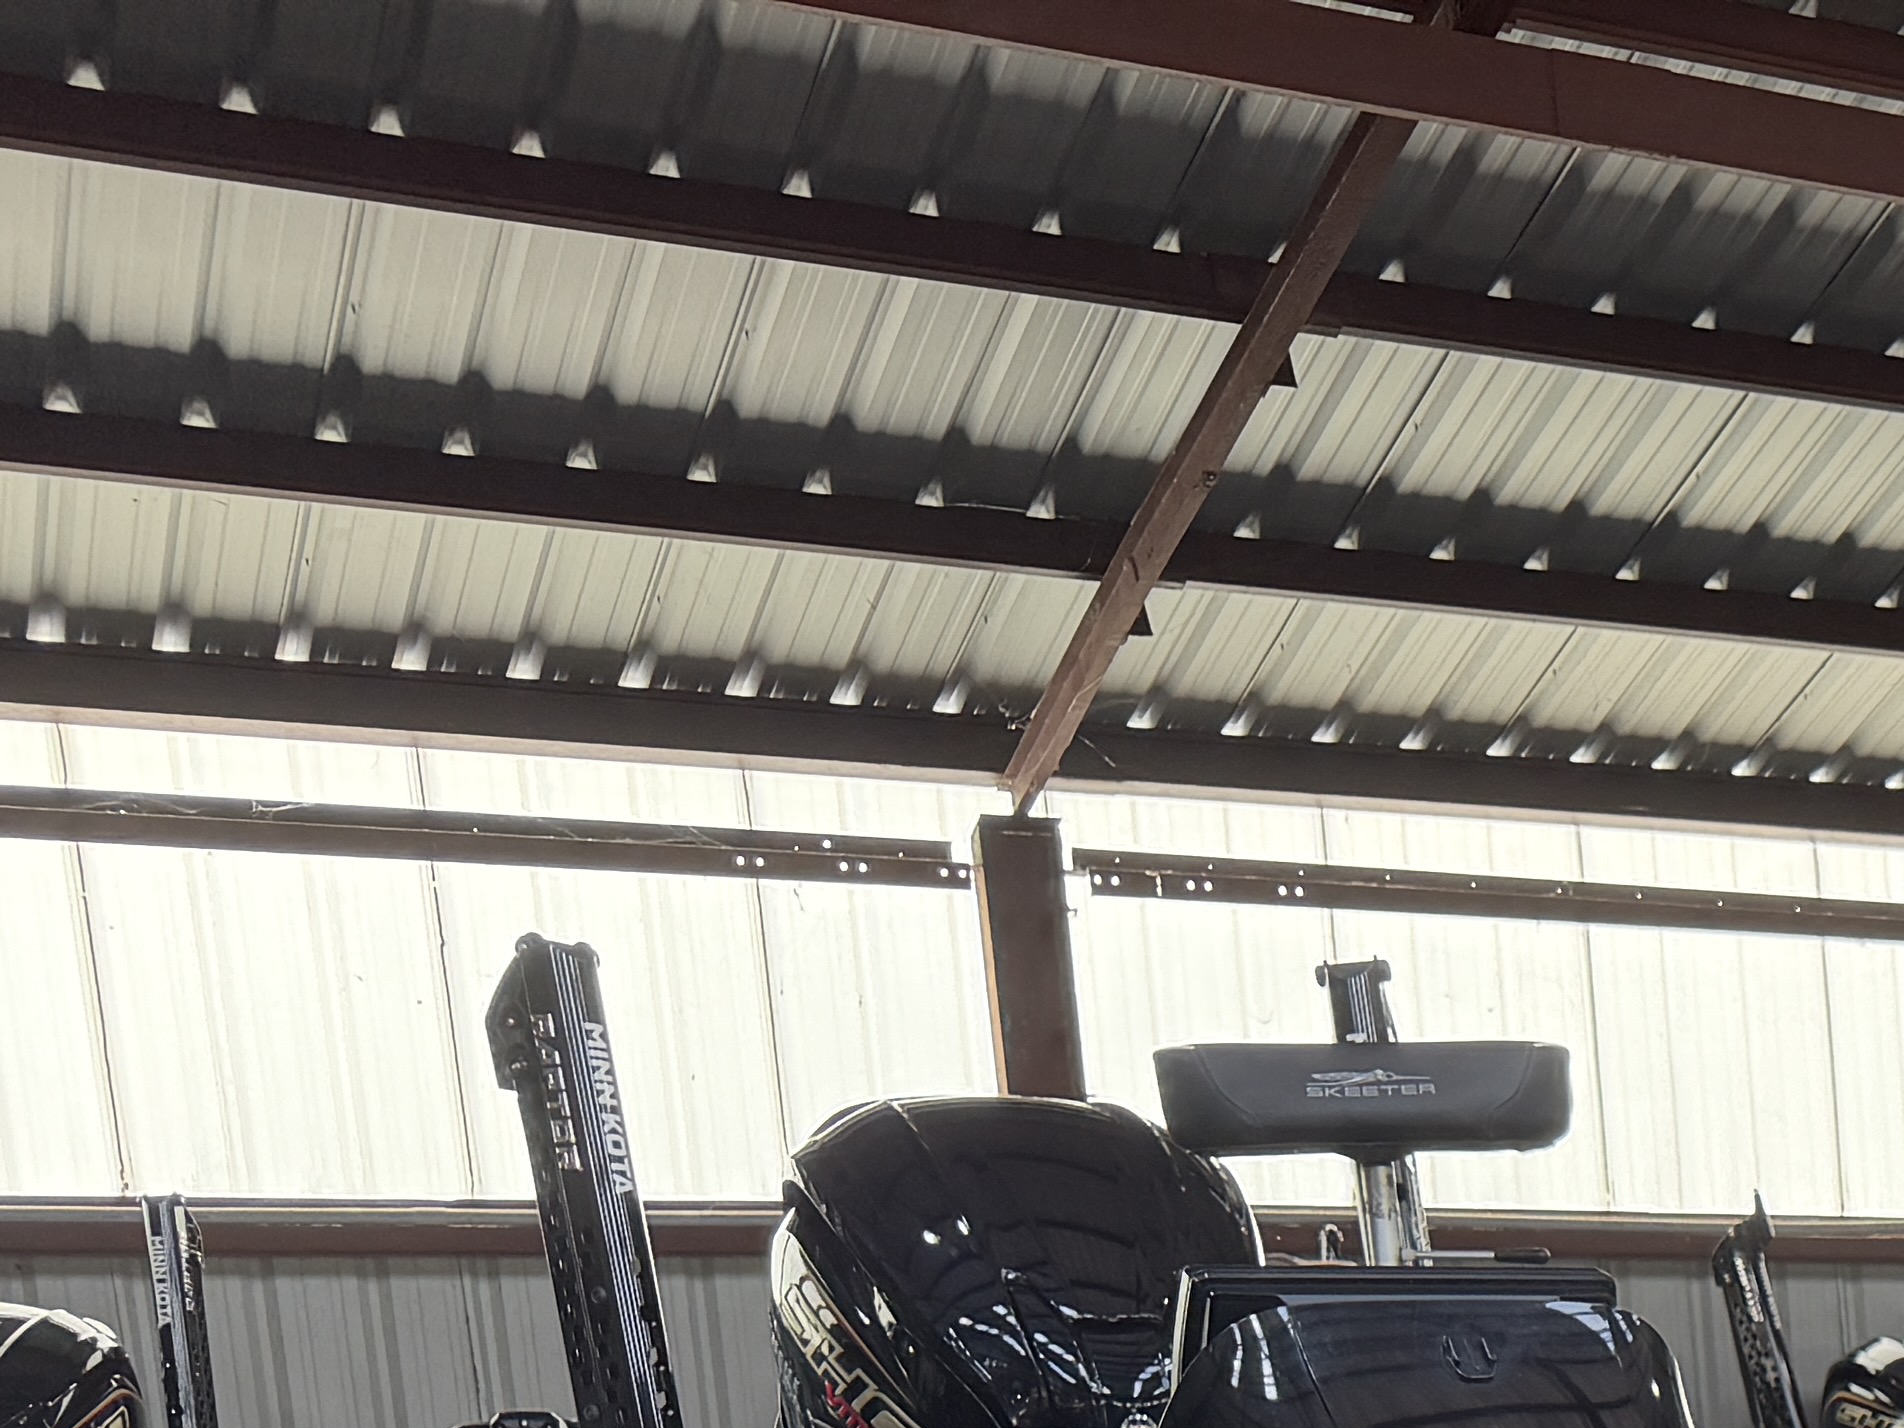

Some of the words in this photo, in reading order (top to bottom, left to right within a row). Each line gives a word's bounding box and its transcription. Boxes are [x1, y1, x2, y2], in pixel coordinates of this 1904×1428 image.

[584, 1021, 619, 1112] MINN
[602, 1112, 634, 1194] KOTA
[1306, 1083, 1436, 1097] SKEETER
